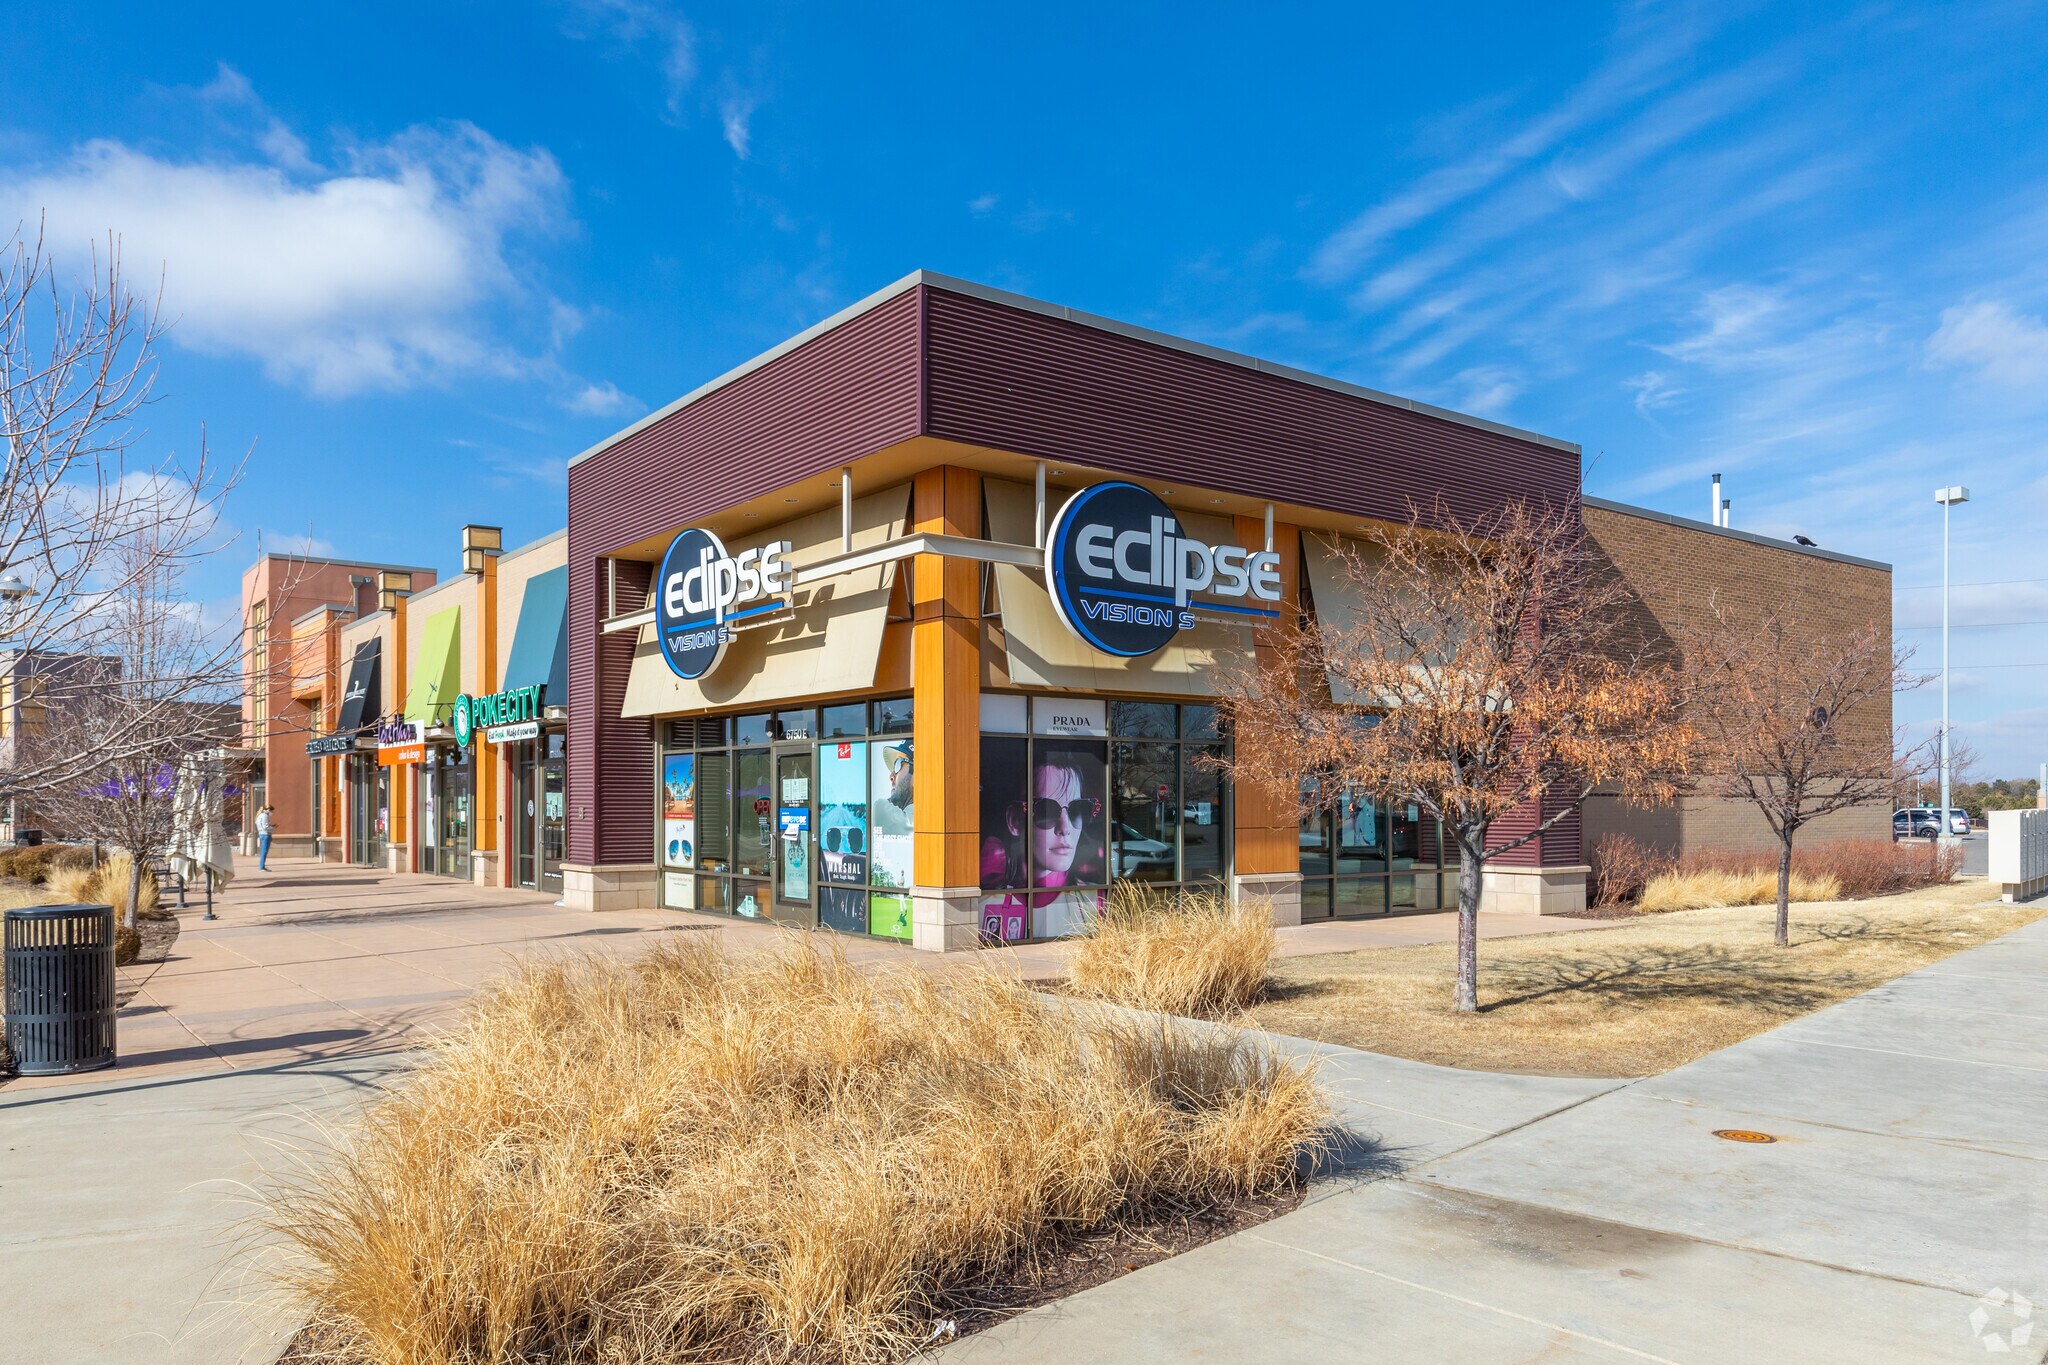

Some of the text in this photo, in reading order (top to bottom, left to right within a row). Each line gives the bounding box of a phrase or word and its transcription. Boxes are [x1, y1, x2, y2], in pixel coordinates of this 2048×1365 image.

[472, 684, 541, 728] POKECITY
[1053, 716, 1091, 726] PRADA
[786, 729, 802, 740] 6750
[828, 862, 861, 875] MARSHAL
